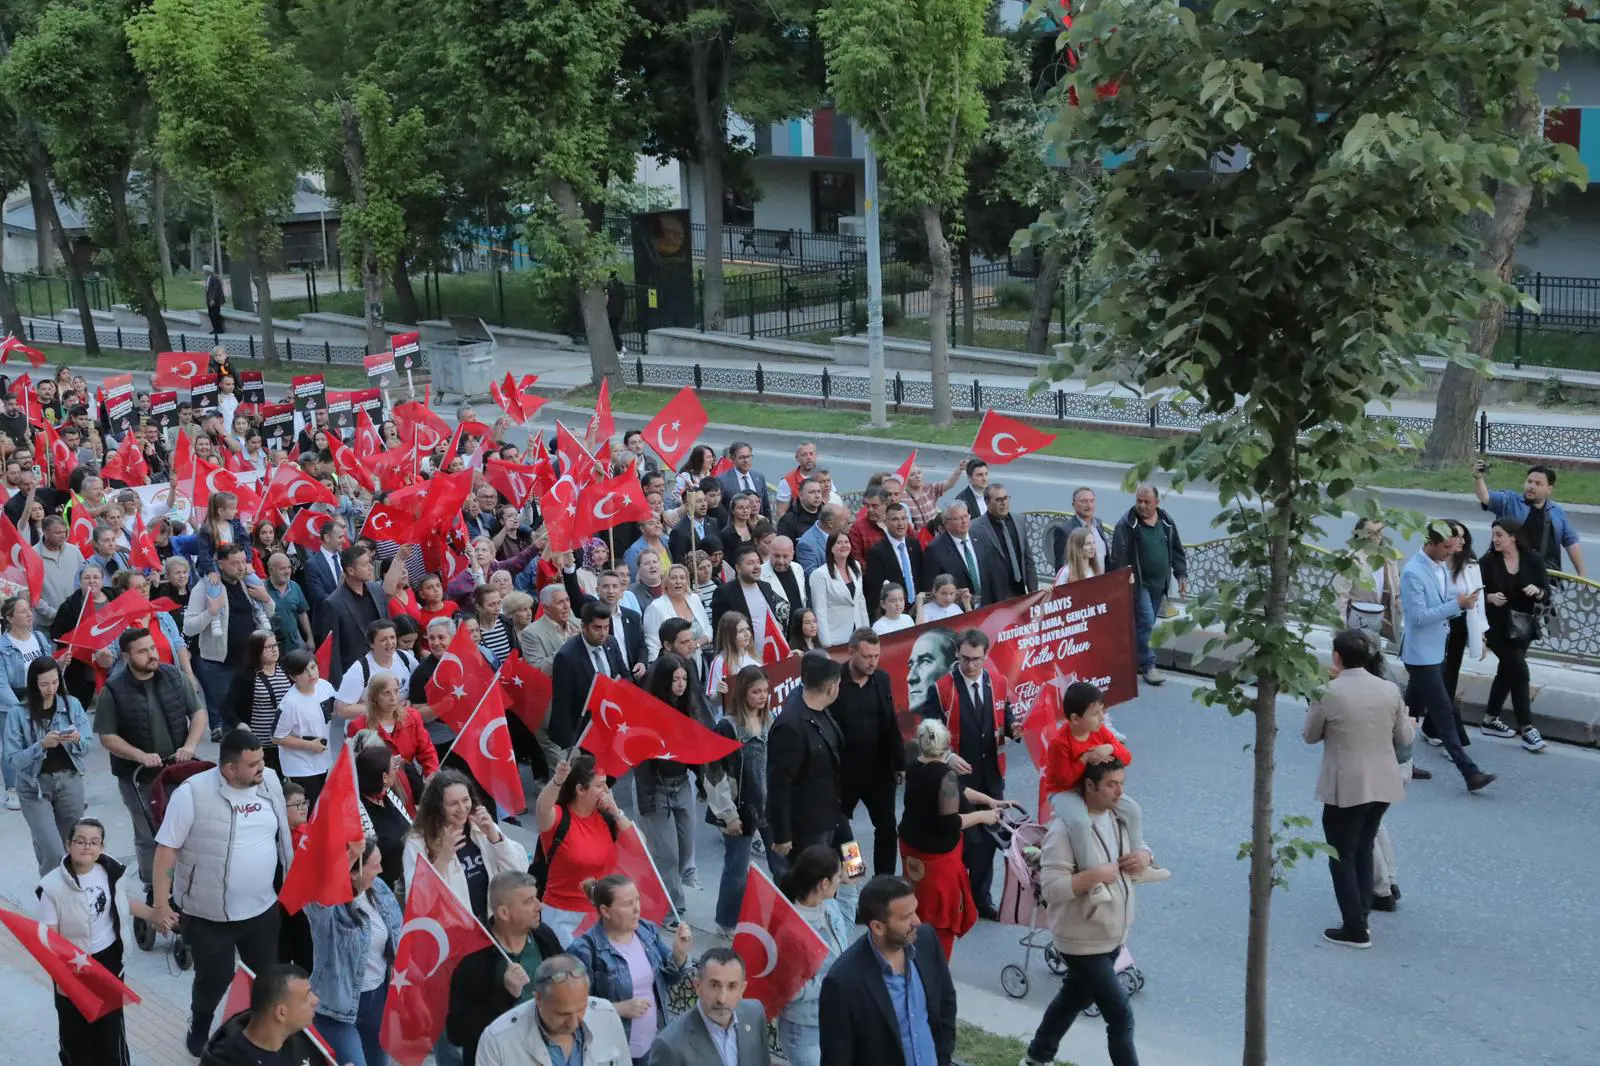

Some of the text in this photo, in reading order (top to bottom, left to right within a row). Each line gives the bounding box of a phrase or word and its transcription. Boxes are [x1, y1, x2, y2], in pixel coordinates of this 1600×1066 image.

[1029, 596, 1072, 618] 19 MAYIS
[997, 620, 1040, 643] ATATÜRK'Ü
[1066, 604, 1096, 622] GENÇLİK
[1097, 603, 1107, 615] VE
[1017, 635, 1040, 650] SPOR
[1021, 638, 1091, 671] Kutlu Olsun
